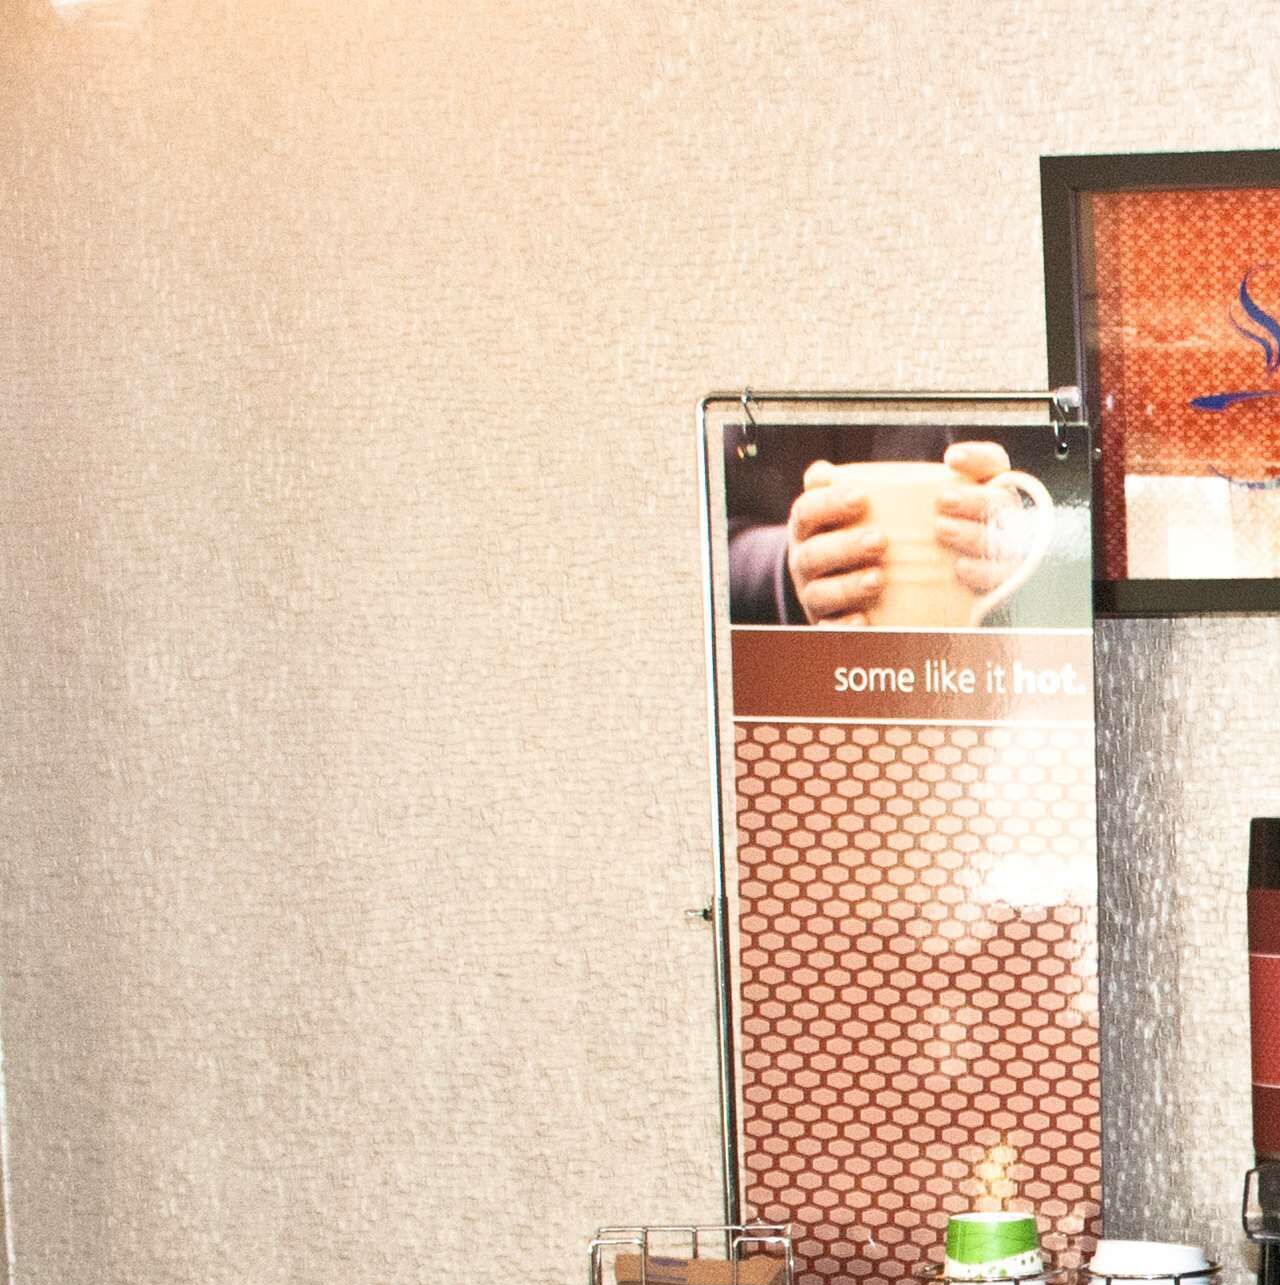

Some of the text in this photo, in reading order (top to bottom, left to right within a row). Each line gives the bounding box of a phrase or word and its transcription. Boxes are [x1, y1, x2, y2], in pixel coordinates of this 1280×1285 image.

[834, 658, 1089, 695] some like it hot.
